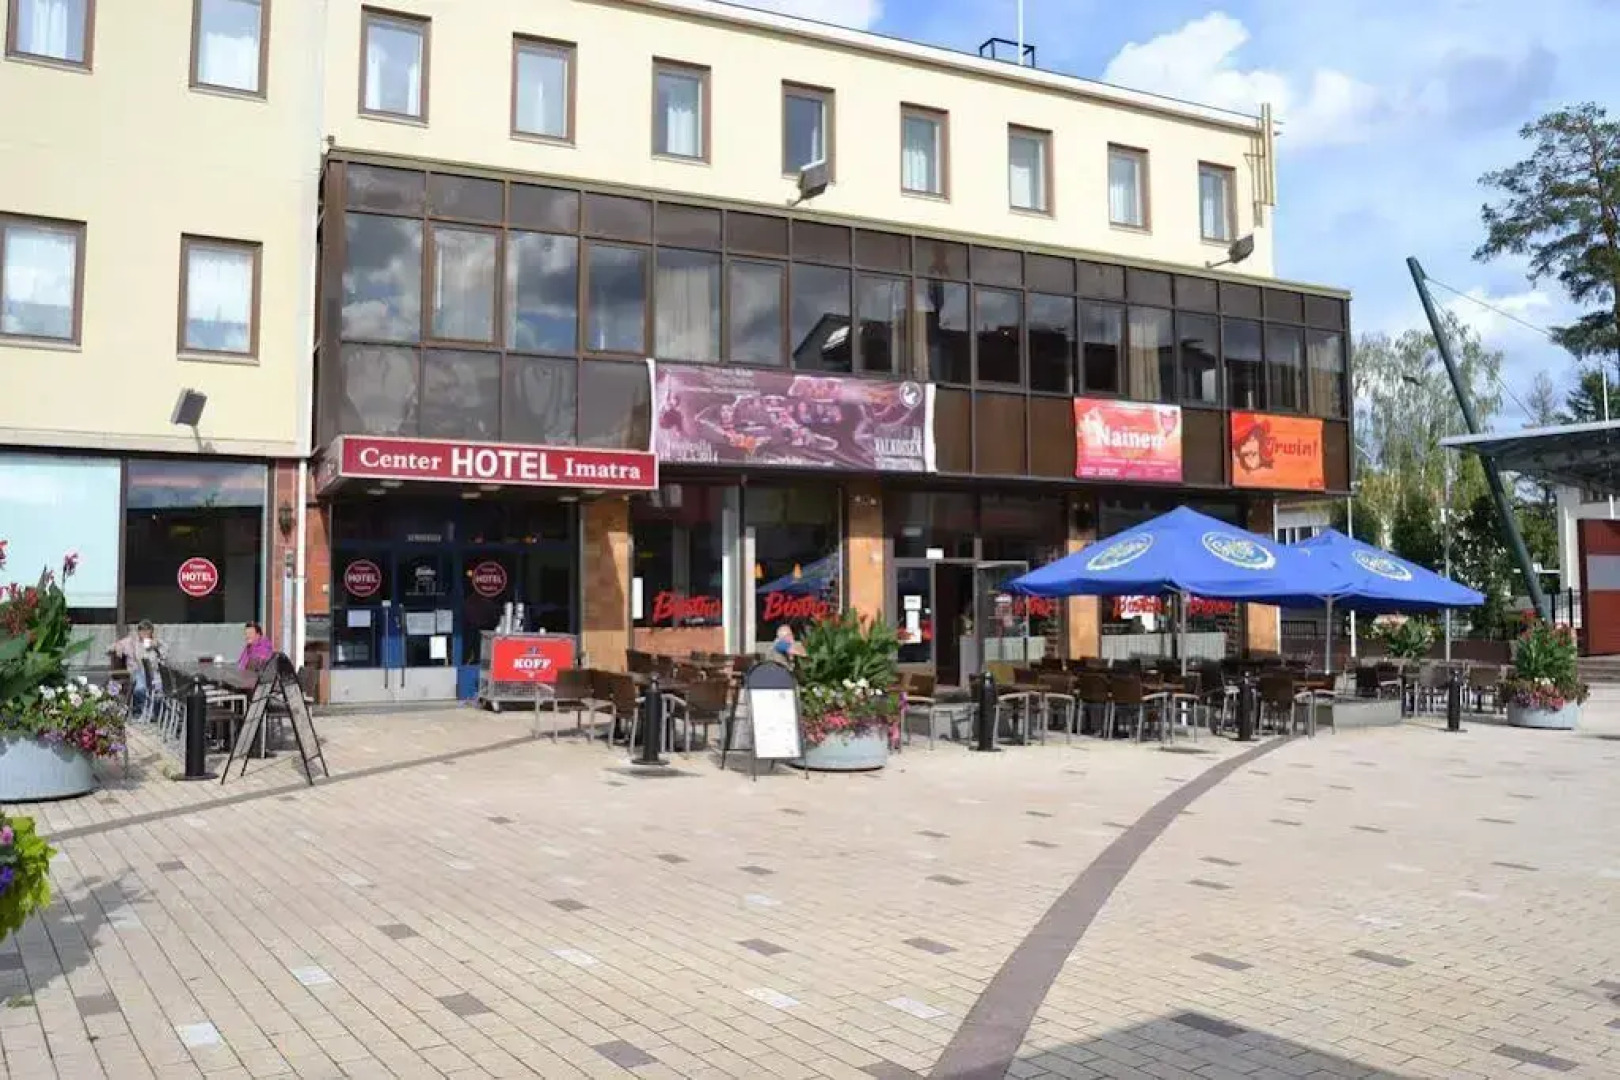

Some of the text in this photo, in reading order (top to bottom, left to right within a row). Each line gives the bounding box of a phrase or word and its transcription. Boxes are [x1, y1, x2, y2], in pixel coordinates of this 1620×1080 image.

[360, 447, 442, 471] Center
[451, 448, 558, 481] HOTEL
[564, 458, 641, 481] Imatra
[181, 571, 214, 581] HOTEL
[347, 573, 377, 583] HOTEL
[763, 591, 829, 622] Bistro
